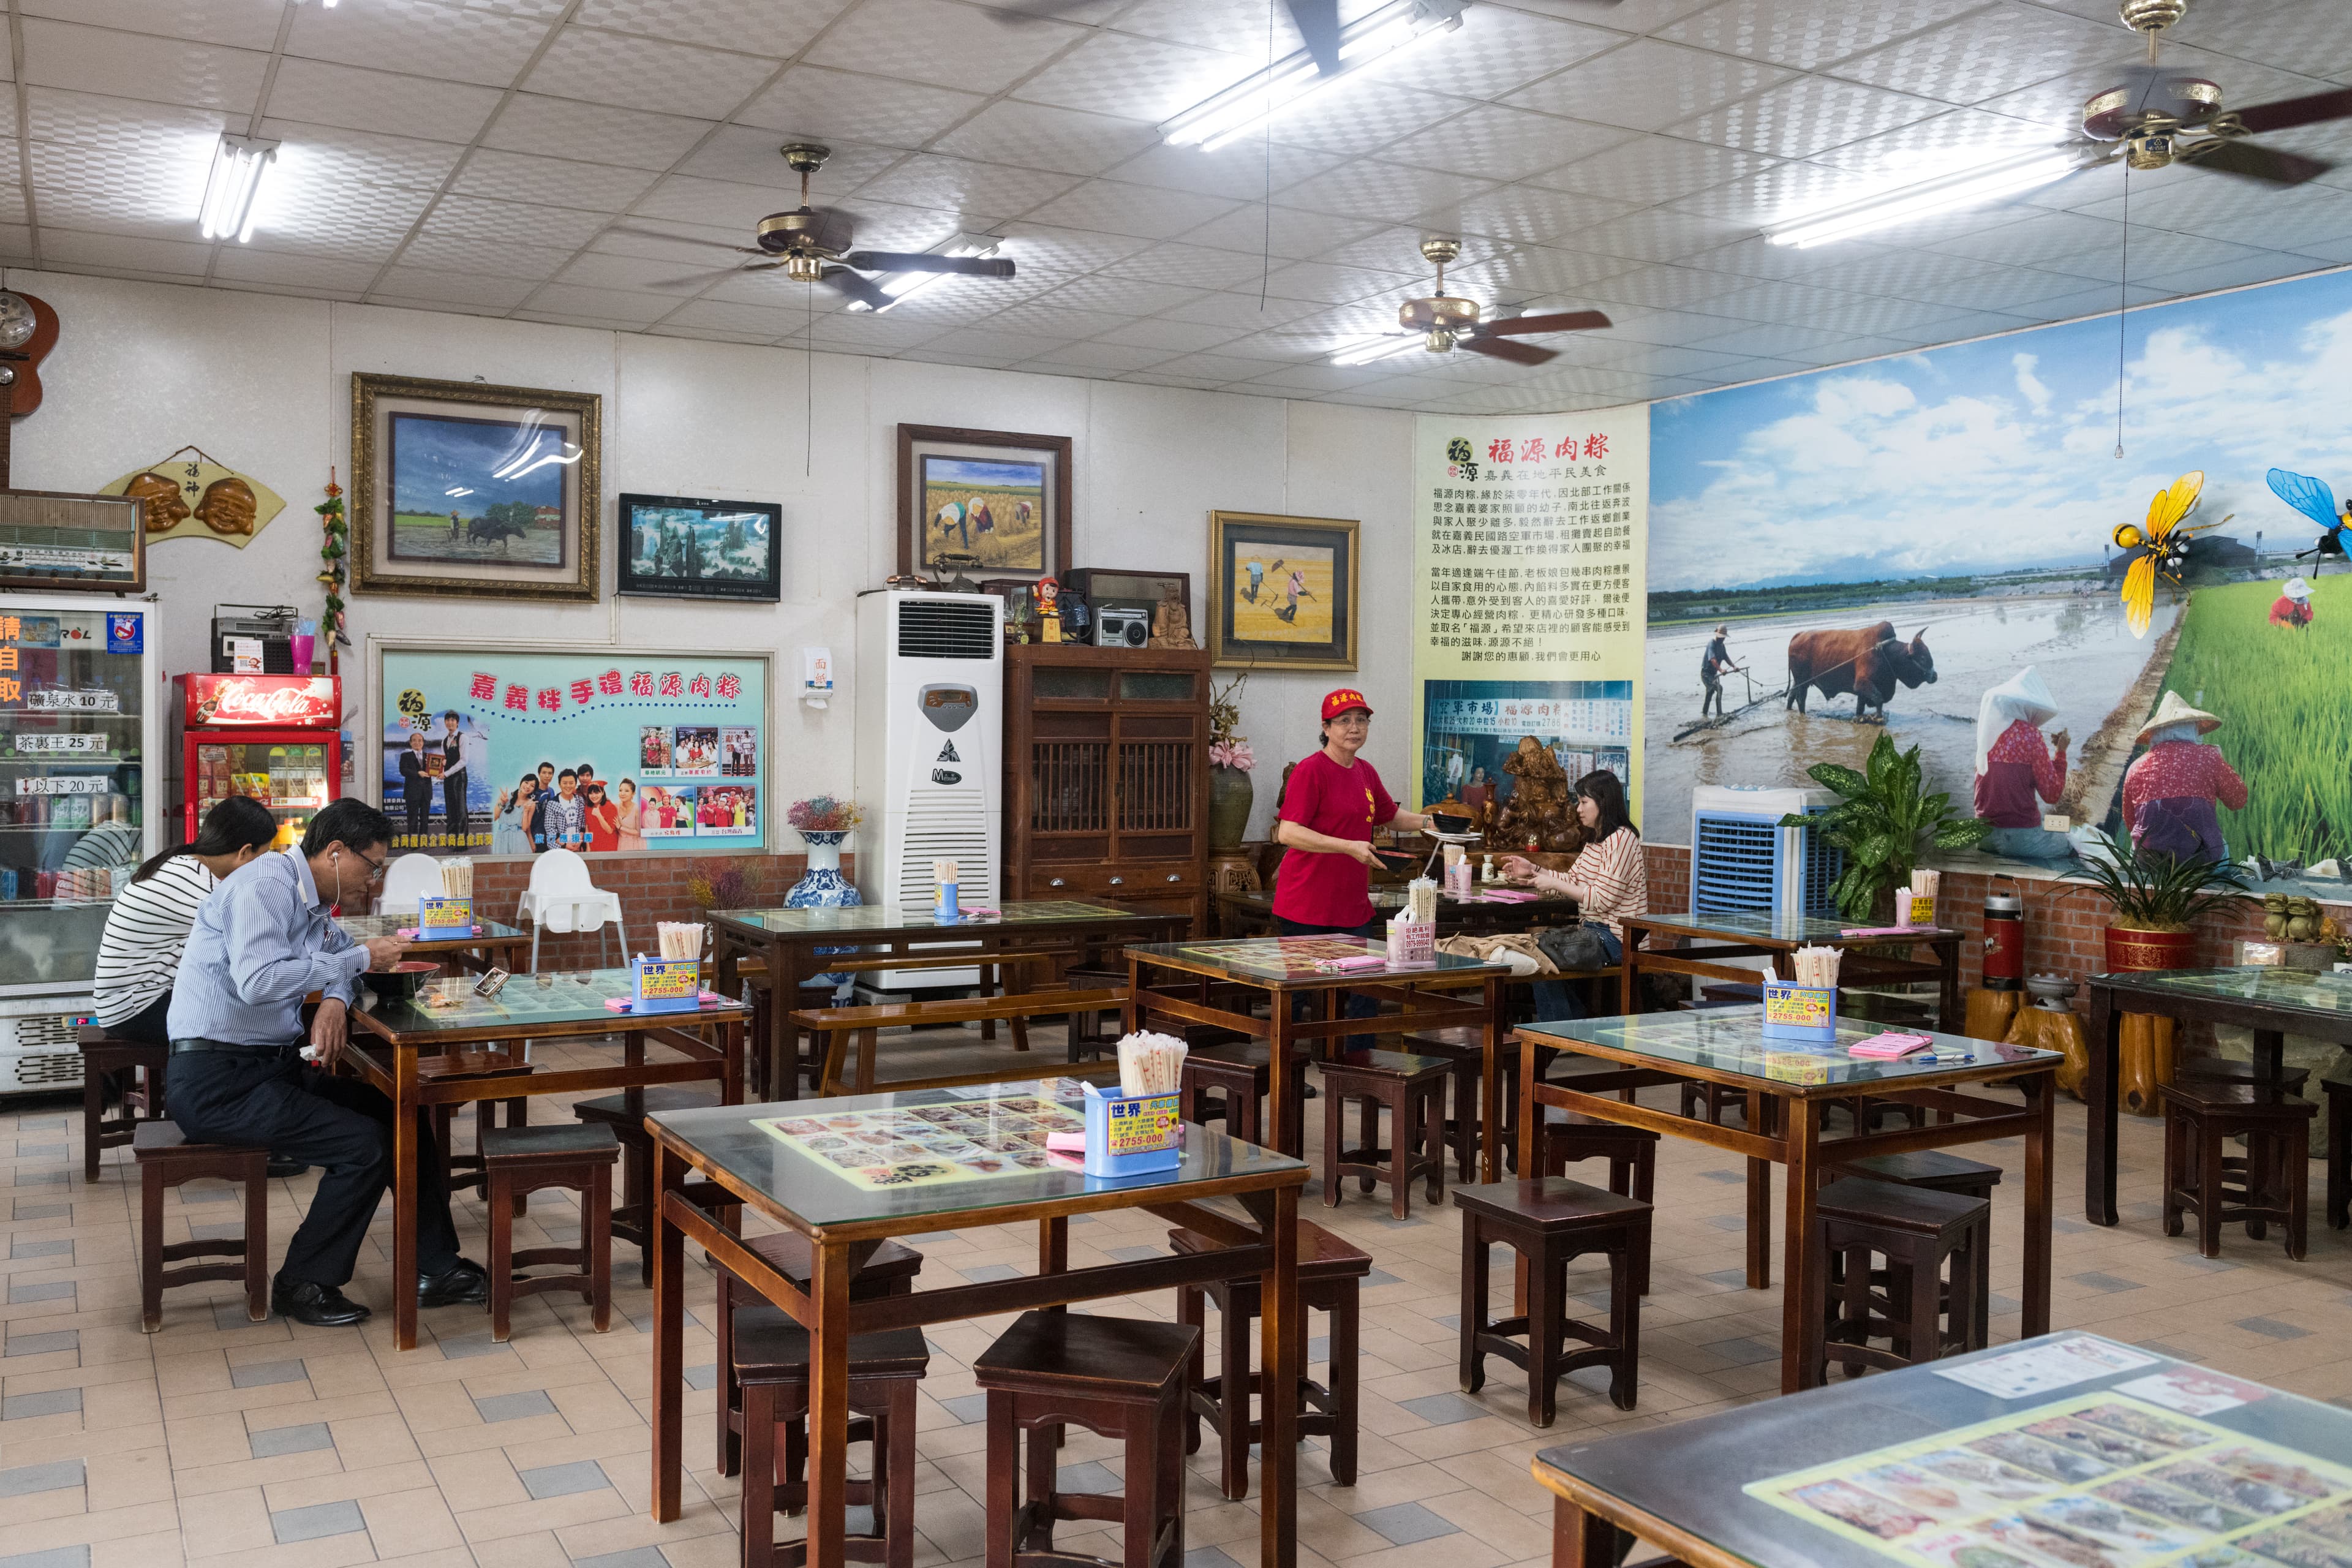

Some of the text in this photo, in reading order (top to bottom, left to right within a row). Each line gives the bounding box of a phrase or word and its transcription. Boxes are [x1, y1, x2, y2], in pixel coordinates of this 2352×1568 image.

[1488, 432, 1610, 464] 福源肉粽
[1485, 464, 1607, 481] 嘉義在地平民美食
[630, 672, 741, 700] 福源肉粽
[80, 696, 96, 706] 10
[100, 696, 114, 709] 元
[221, 687, 311, 714] Coca-Cola
[18, 736, 104, 750] 茶裏王 25 元
[36, 780, 104, 793] 以下 20 元
[643, 965, 666, 974] 世界
[1768, 989, 1792, 1000] 世界
[1111, 1102, 1140, 1118] 世界
[1120, 1134, 1163, 1147] 2755-000
